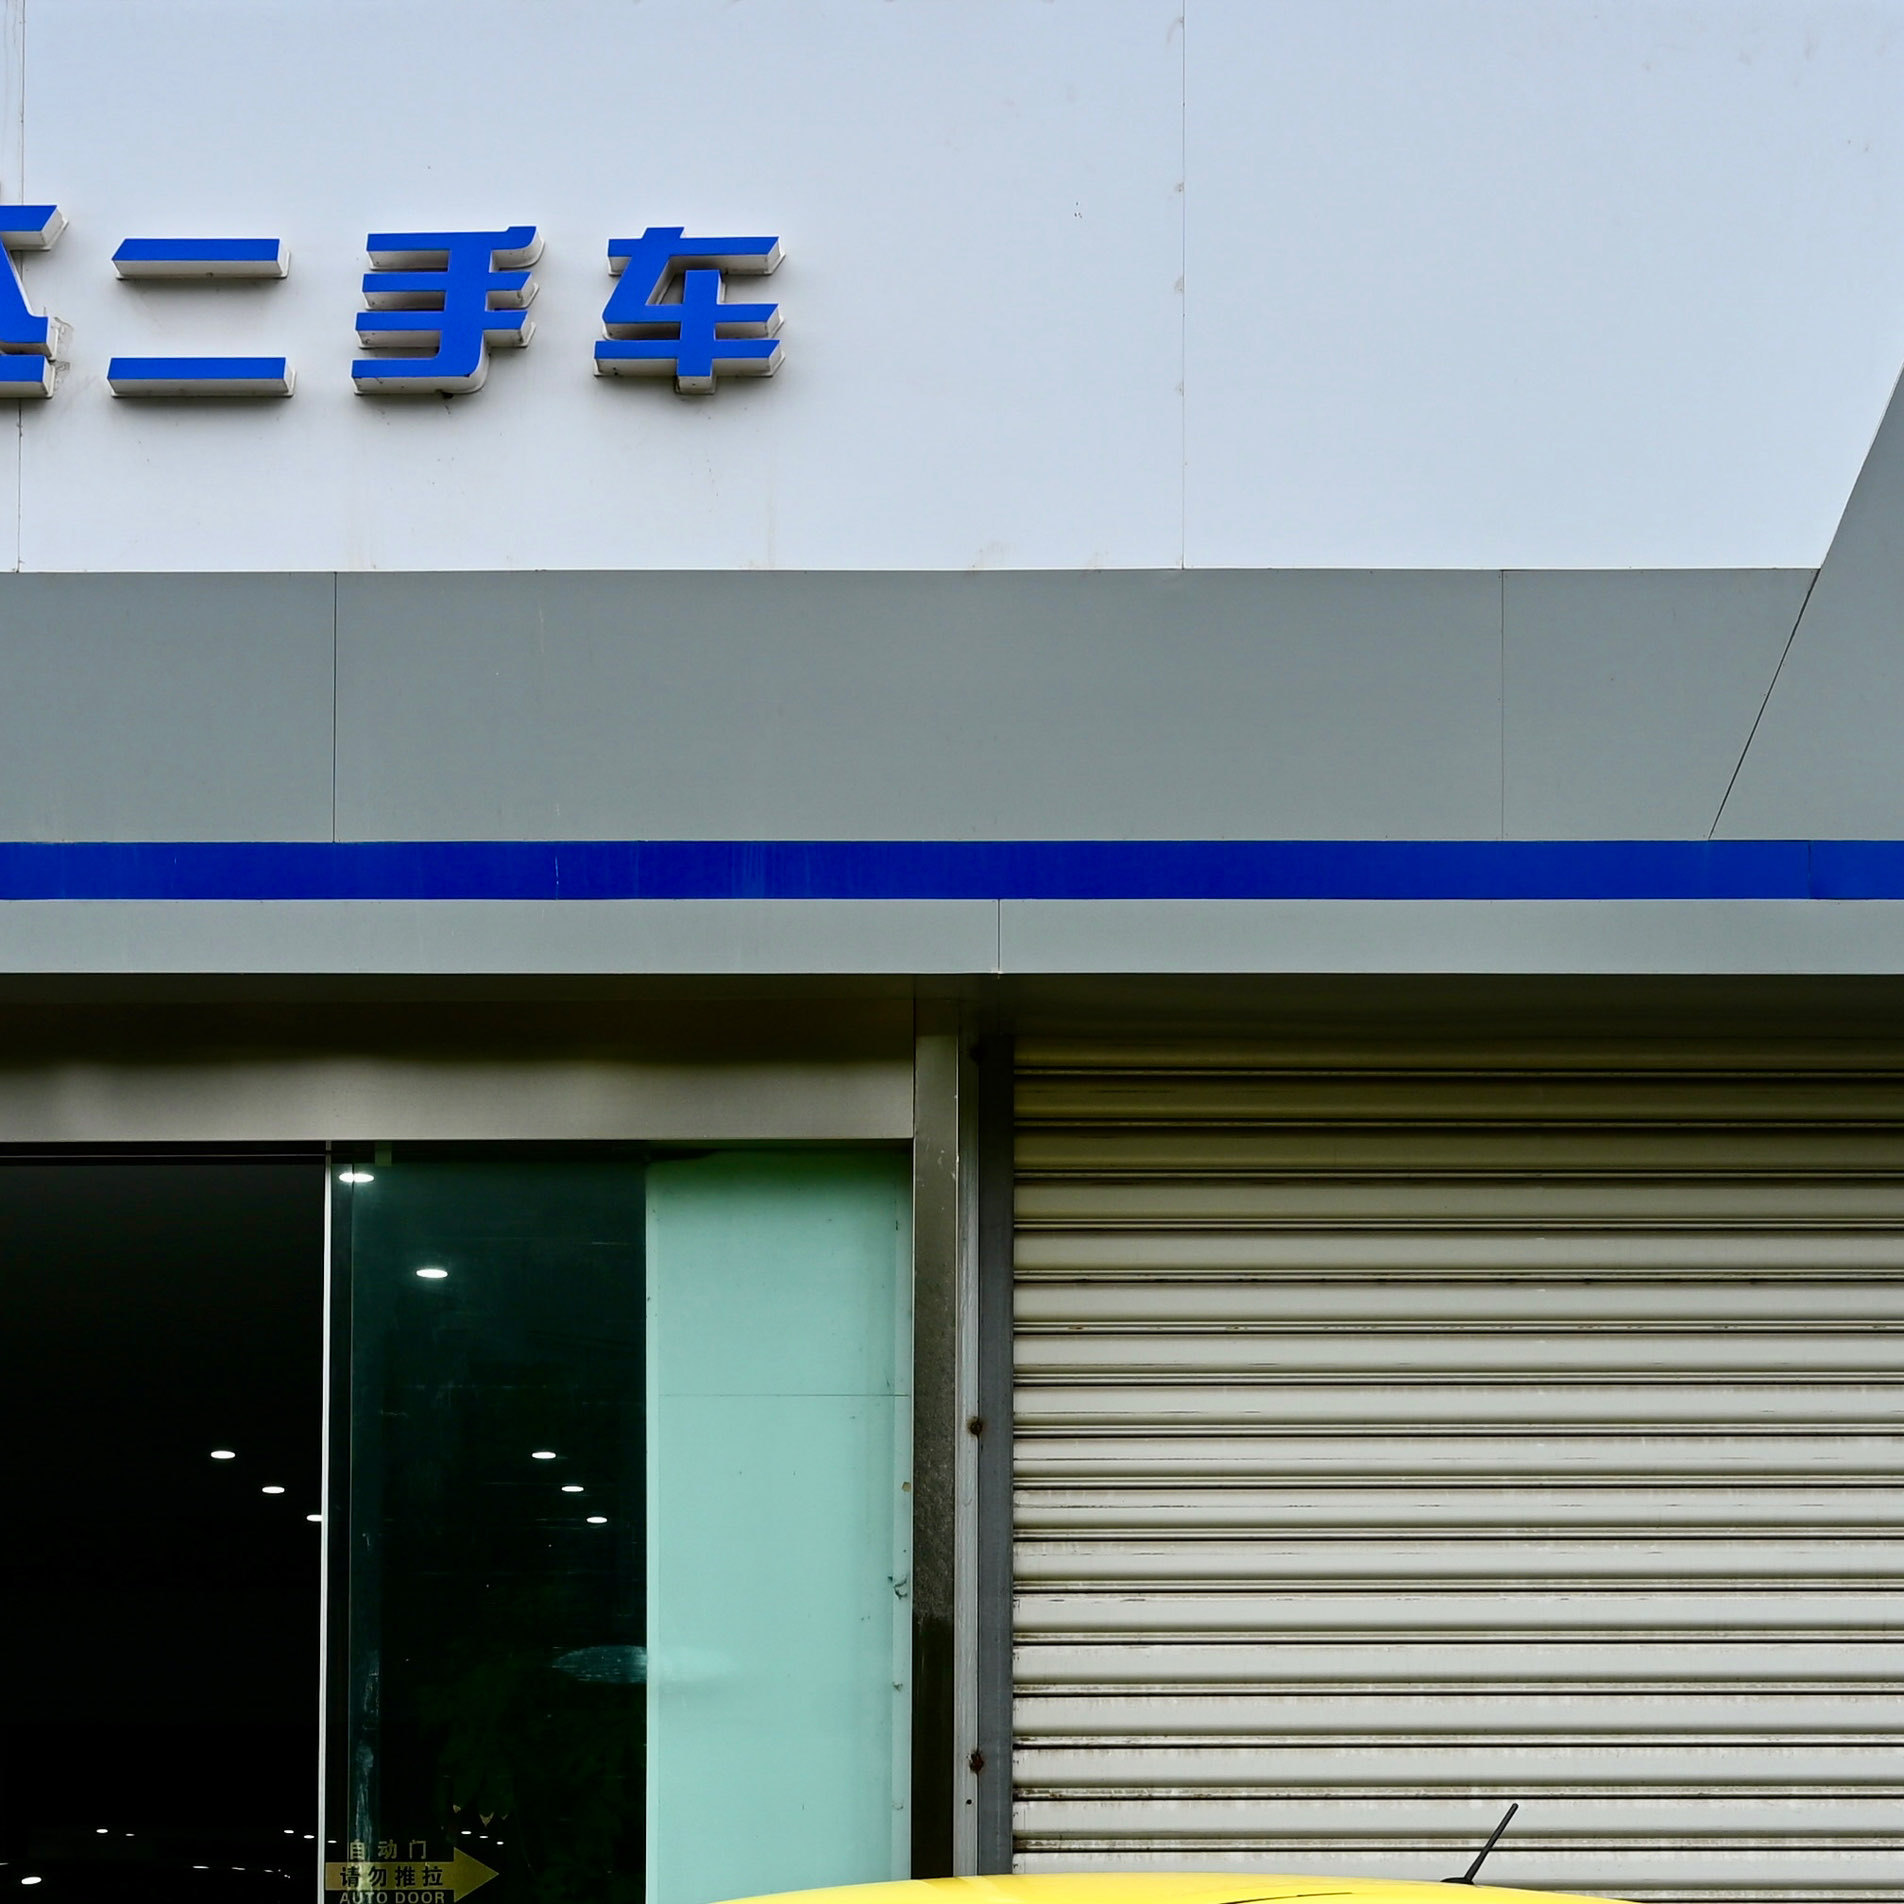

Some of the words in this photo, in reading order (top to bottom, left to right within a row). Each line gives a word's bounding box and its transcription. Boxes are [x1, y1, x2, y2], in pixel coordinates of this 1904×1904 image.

[349, 1839, 427, 1860] 自动门
[339, 1866, 443, 1888] 请勿推拉
[339, 1891, 388, 1904] AUTO
[396, 1891, 445, 1904] DOOR
